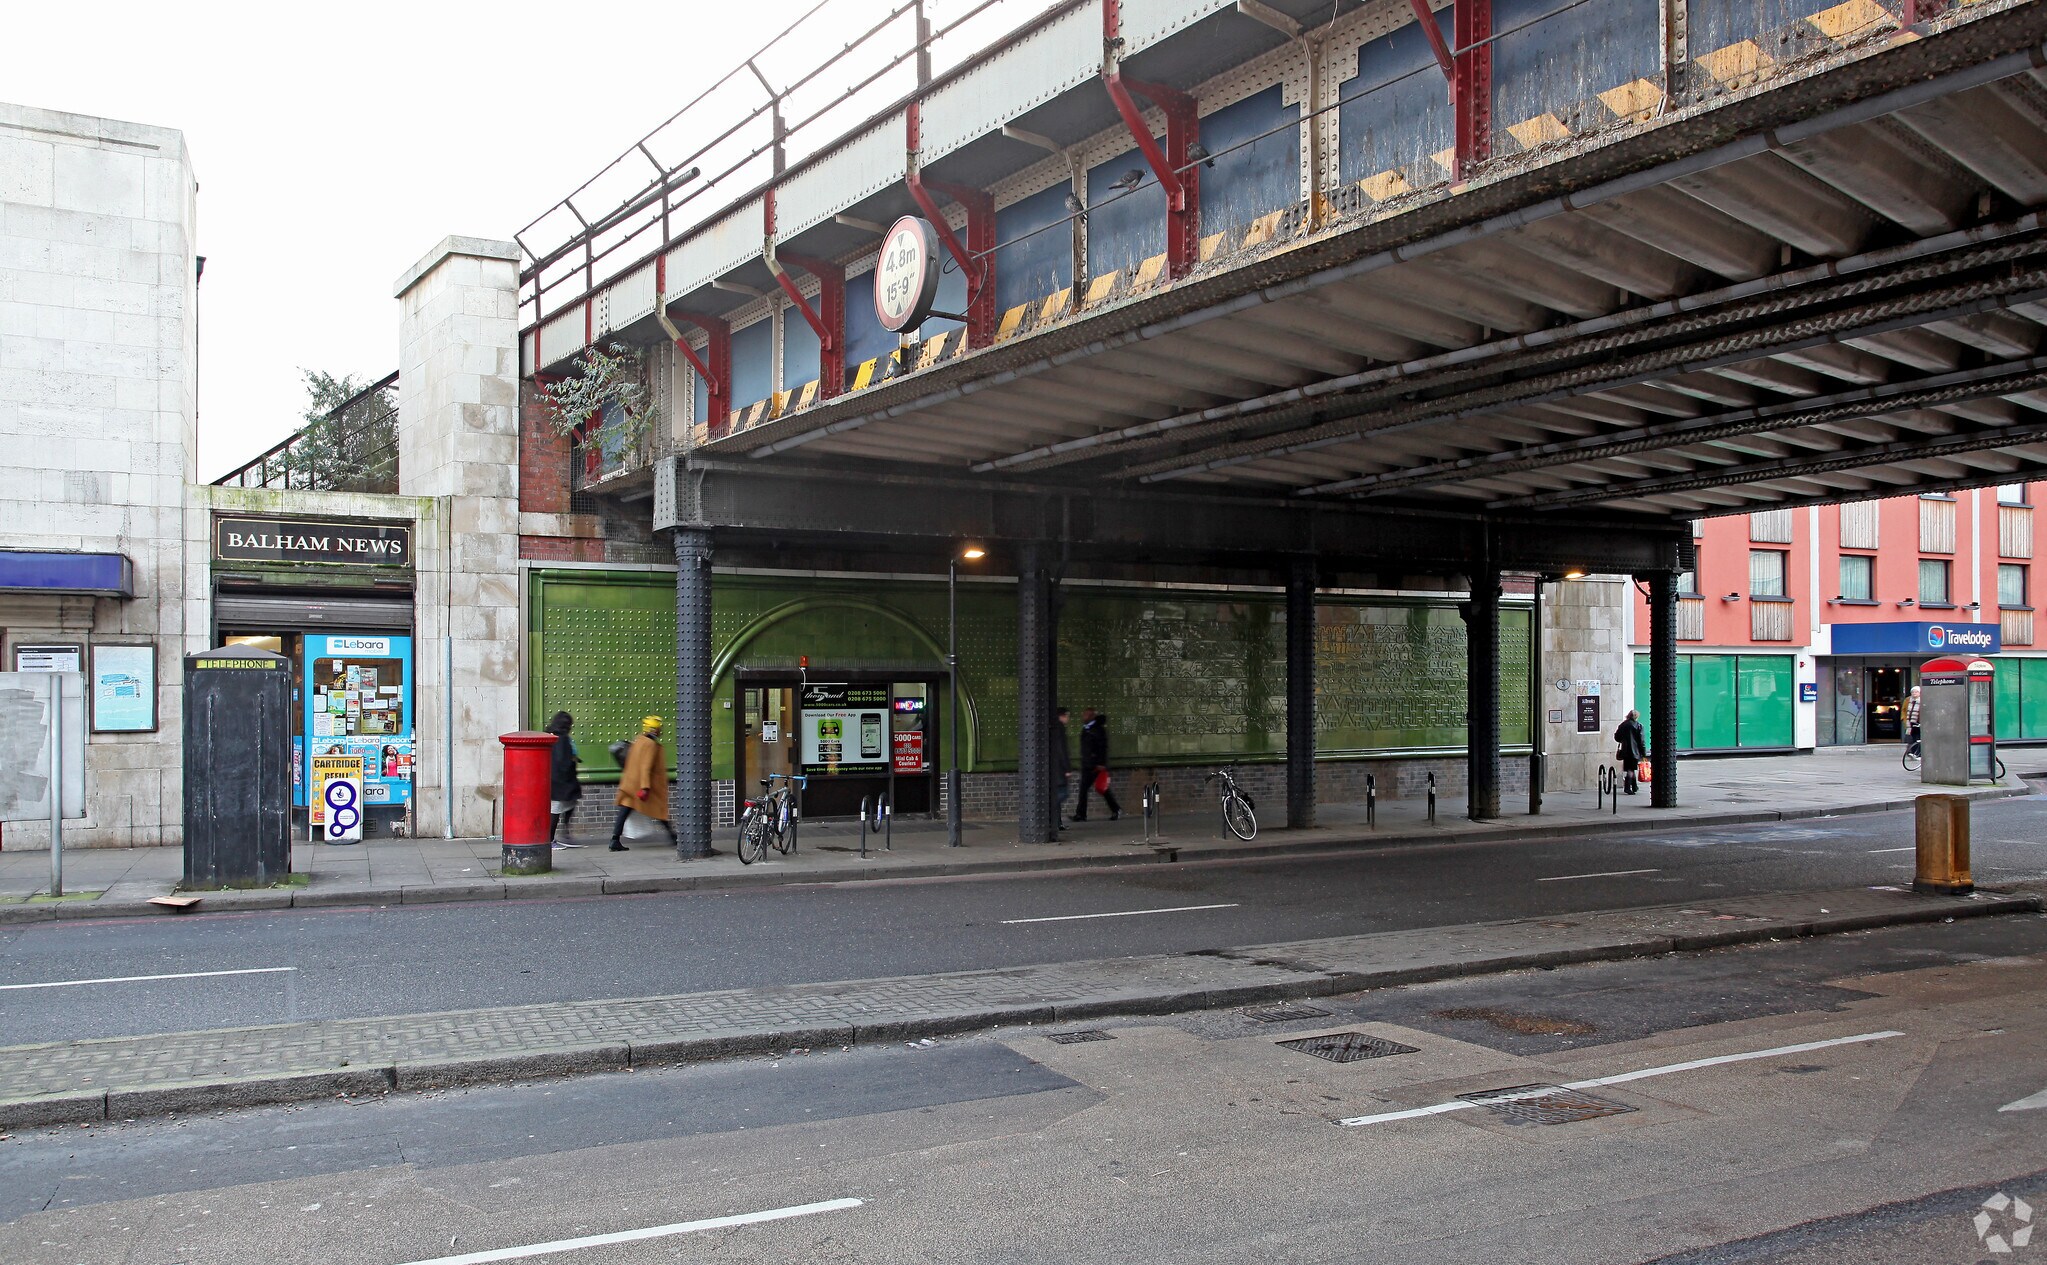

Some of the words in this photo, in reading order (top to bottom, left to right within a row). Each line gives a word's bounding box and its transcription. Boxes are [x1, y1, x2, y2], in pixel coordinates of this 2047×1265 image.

[885, 247, 916, 272] 4.8m
[227, 532, 329, 551] BALHAM
[336, 537, 402, 554] NEWS
[1946, 629, 1992, 648] Travelodge
[343, 639, 384, 649] Lebara
[204, 659, 269, 669] TELEPHONE
[353, 736, 380, 744] Lebara
[894, 734, 912, 742] 5000
[314, 759, 361, 769] CARTRIDGE
